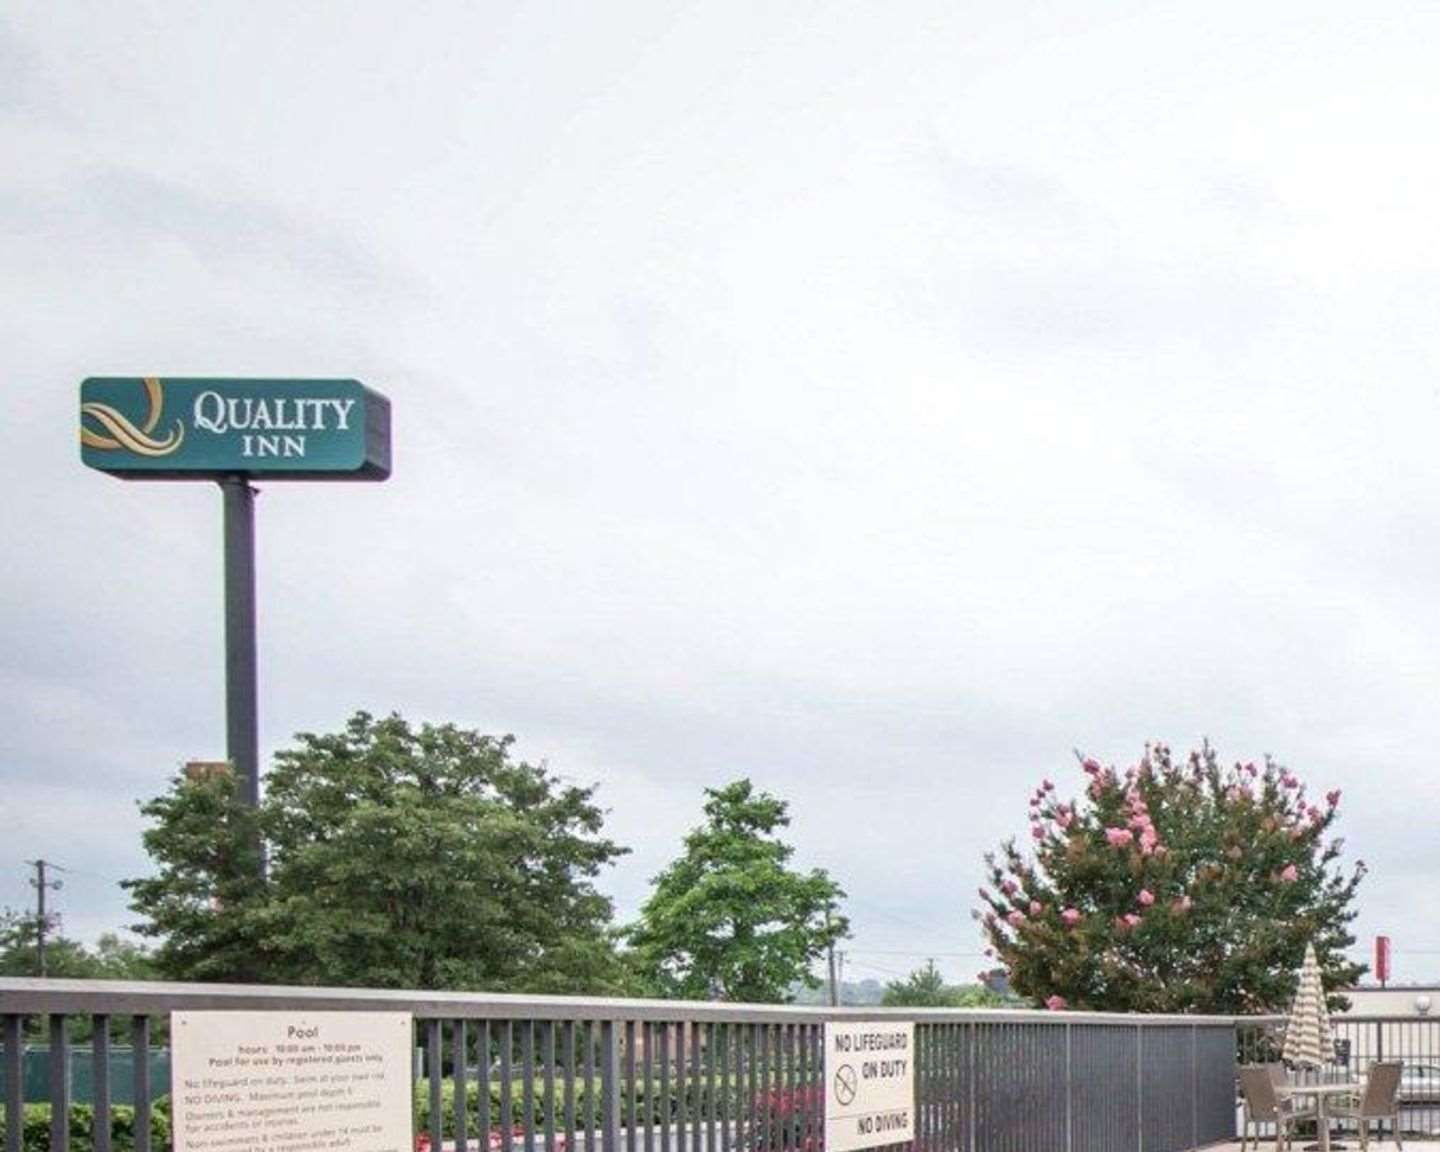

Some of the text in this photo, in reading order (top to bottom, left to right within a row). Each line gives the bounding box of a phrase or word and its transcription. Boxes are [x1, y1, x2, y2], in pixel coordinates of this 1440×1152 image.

[193, 391, 355, 434] QUALITY
[242, 435, 305, 457] INN
[287, 1025, 319, 1039] Pool
[348, 1044, 362, 1054] pm
[835, 1032, 907, 1052] NO LIFEGUARD
[208, 1057, 233, 1067] Pool
[235, 1056, 250, 1065] for
[253, 1057, 269, 1065] use
[272, 1056, 283, 1067] by
[286, 1054, 332, 1066] registered
[335, 1053, 363, 1065] guests
[862, 1060, 908, 1078] ON DUTY
[202, 1077, 247, 1089] lifeguard
[185, 1095, 201, 1104] NO
[236, 1106, 299, 1118] management
[302, 1105, 315, 1113] are
[318, 1103, 334, 1111] not
[857, 1112, 908, 1135] NO DIVING
